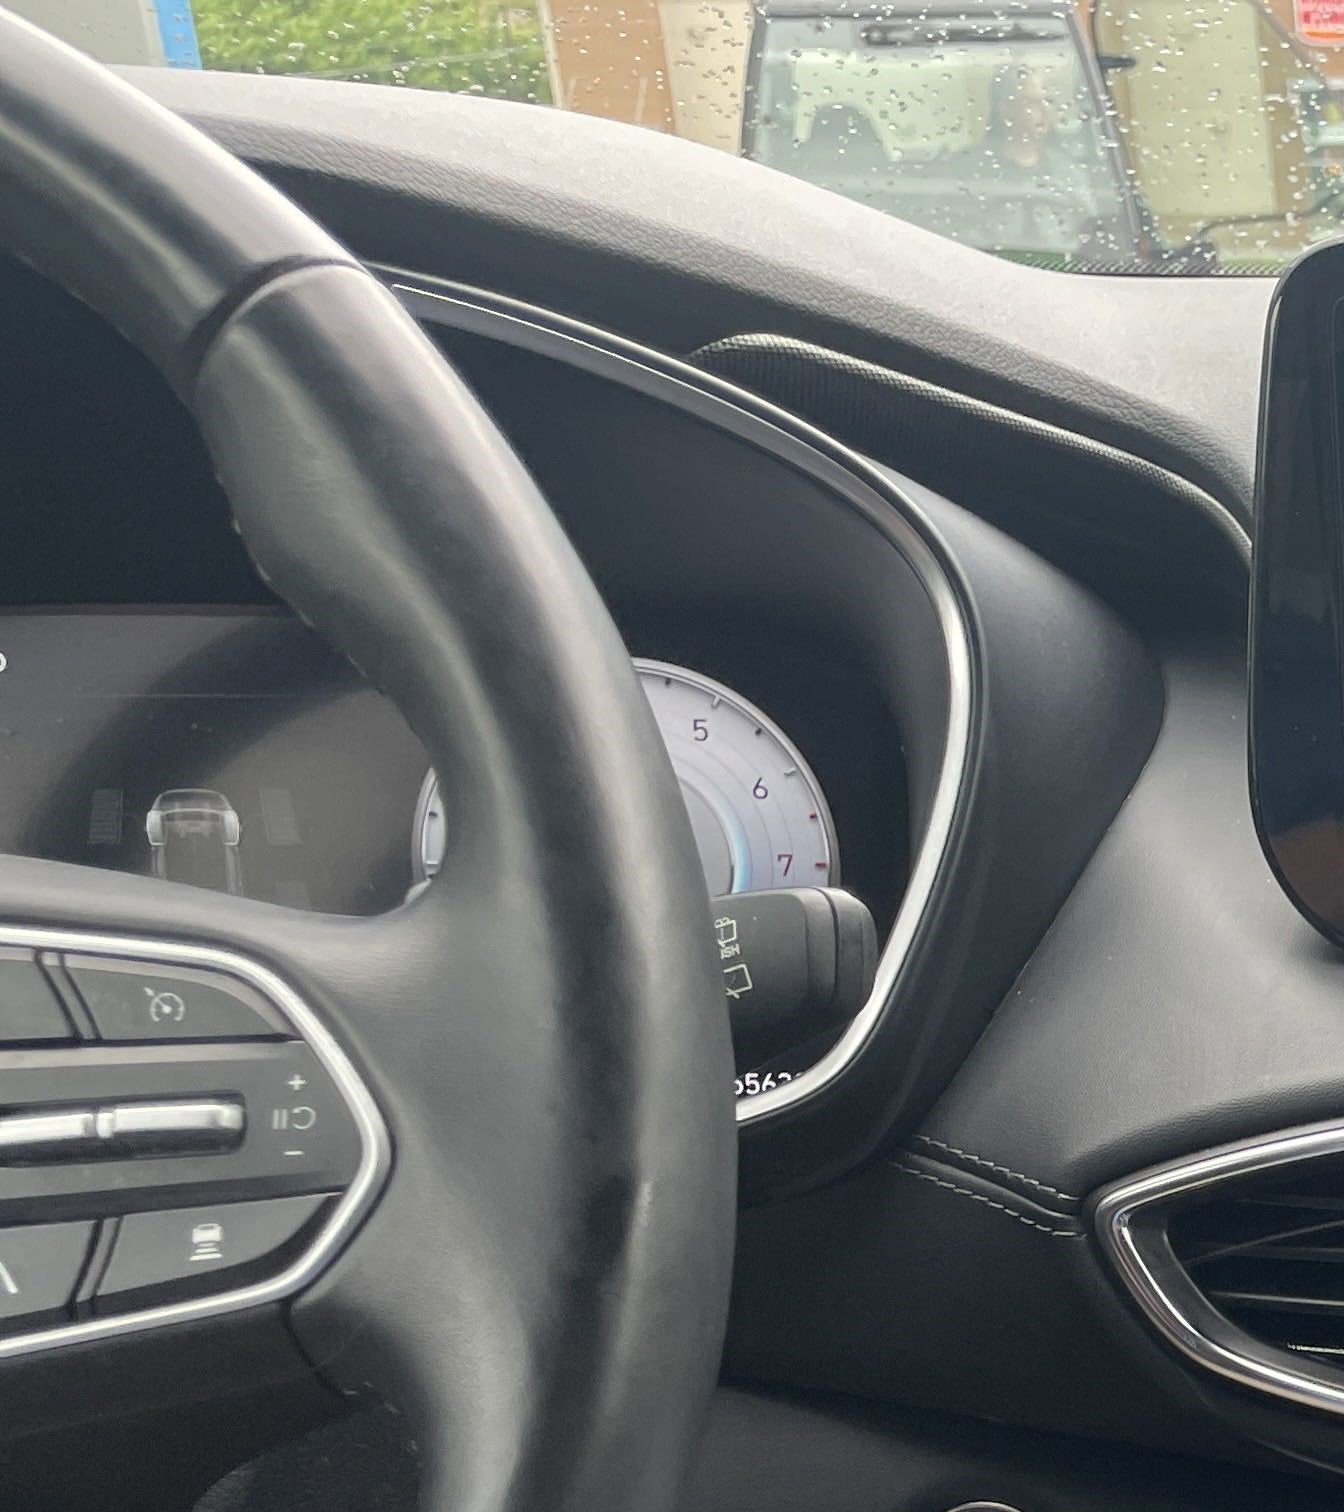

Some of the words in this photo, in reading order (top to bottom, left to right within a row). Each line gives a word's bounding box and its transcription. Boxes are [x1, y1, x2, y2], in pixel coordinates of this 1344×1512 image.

[692, 718, 709, 742] 5
[751, 776, 769, 800] 6
[776, 853, 794, 877] 7
